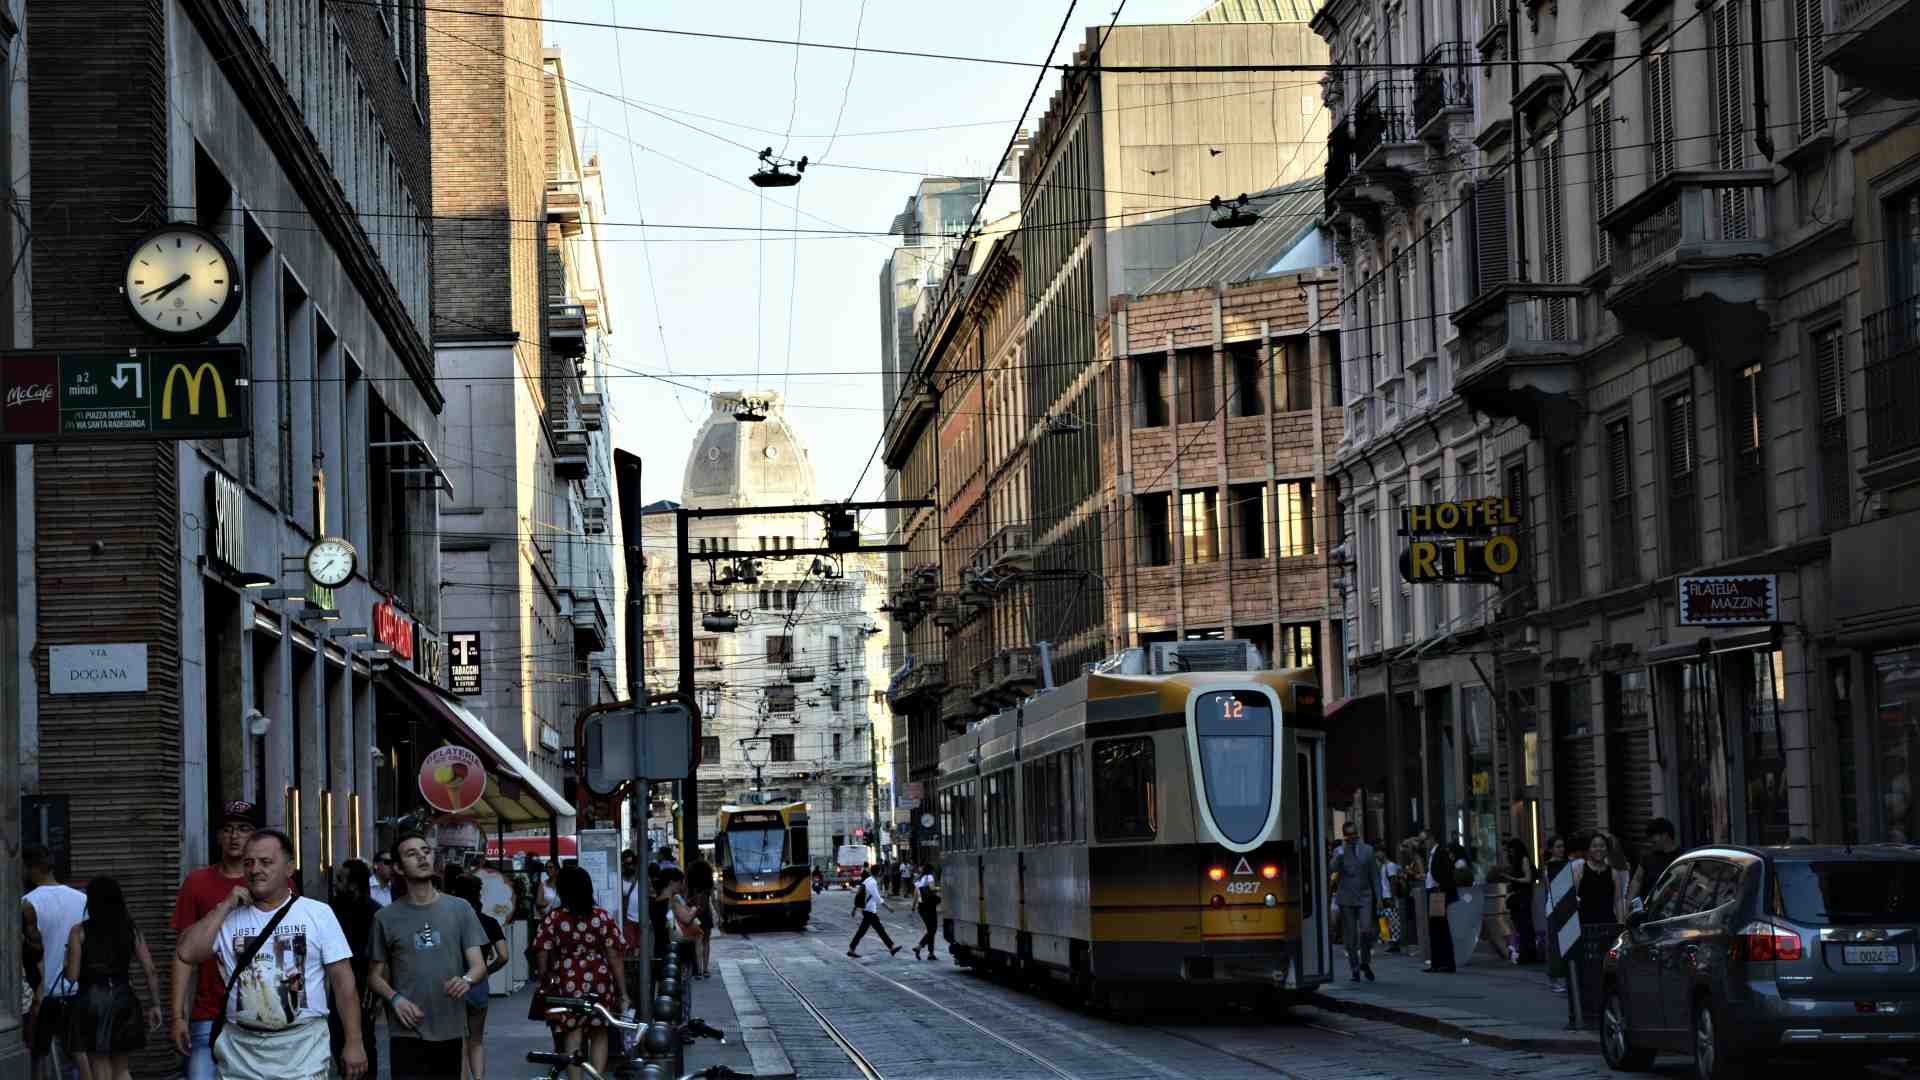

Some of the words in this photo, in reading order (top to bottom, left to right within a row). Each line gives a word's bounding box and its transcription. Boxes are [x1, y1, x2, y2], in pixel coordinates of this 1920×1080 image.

[83, 371, 89, 383] 2
[69, 383, 98, 397] minuti
[85, 410, 107, 419] PIAZZA
[1410, 496, 1520, 531] HOTEL
[1411, 535, 1520, 578] RIO
[1690, 582, 1738, 596] FILATELIA
[1711, 595, 1764, 609] MAZZINI
[88, 648, 108, 657] VIA
[452, 634, 475, 666] T
[70, 669, 128, 681] DOGANA
[451, 665, 479, 676] TABACCHI
[1223, 700, 1244, 719] 12
[1226, 881, 1262, 895] 4927
[233, 927, 257, 937] JUST
